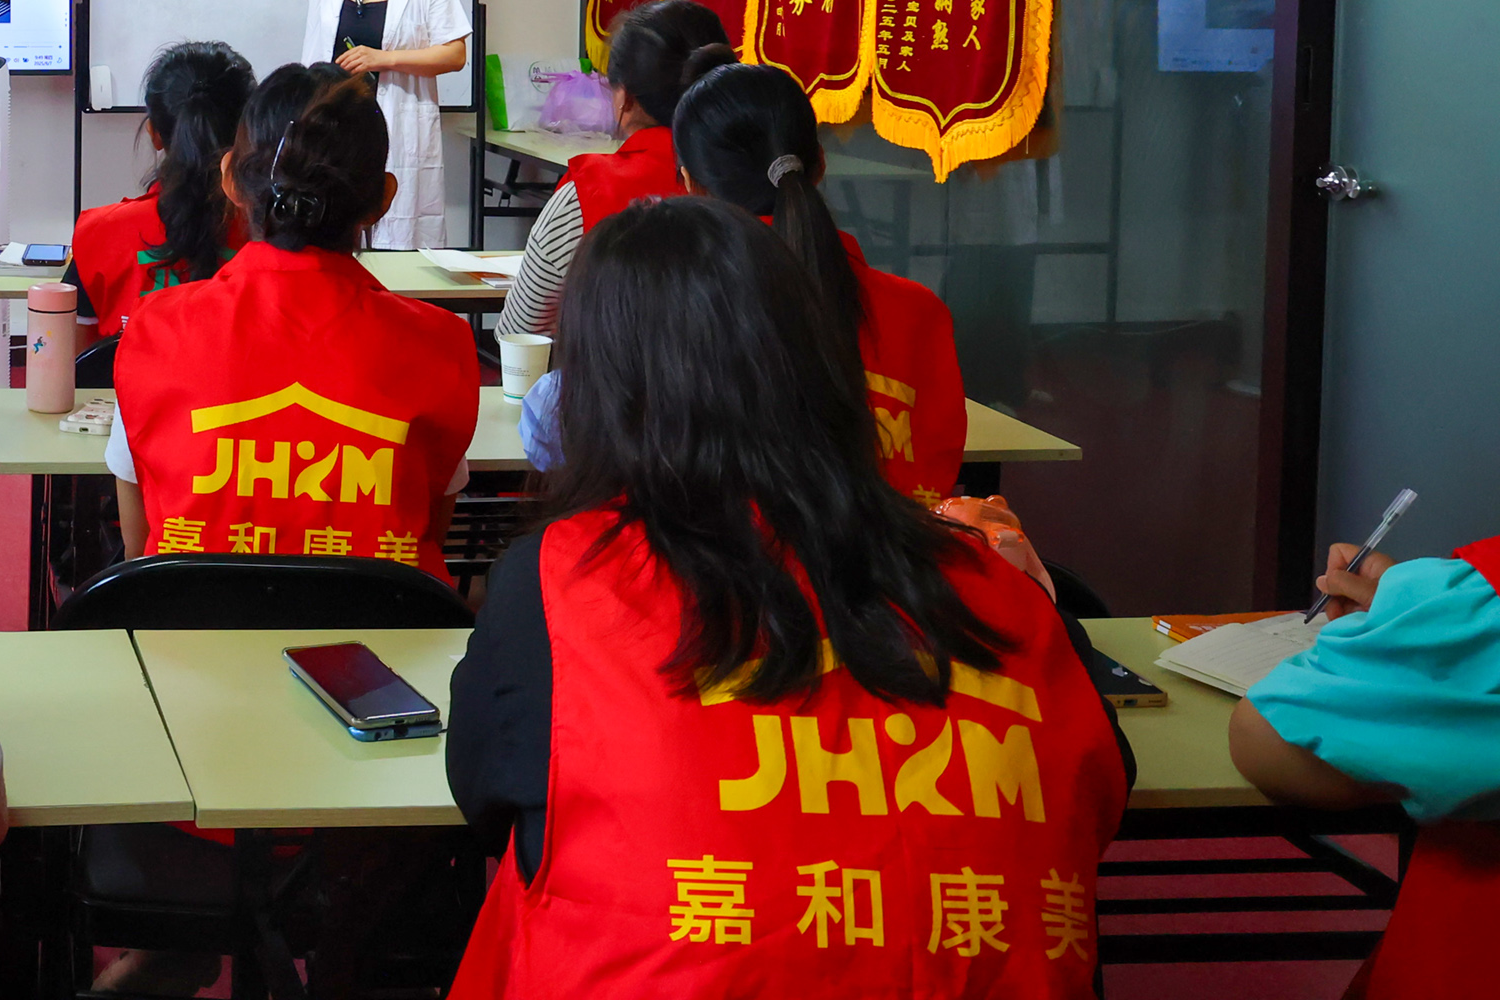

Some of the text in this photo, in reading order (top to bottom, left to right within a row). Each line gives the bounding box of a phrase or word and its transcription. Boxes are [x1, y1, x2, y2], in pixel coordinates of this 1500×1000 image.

[192, 437, 394, 506] JHKM
[718, 712, 1047, 823] JHKM
[666, 854, 1089, 961] 嘉和康美
